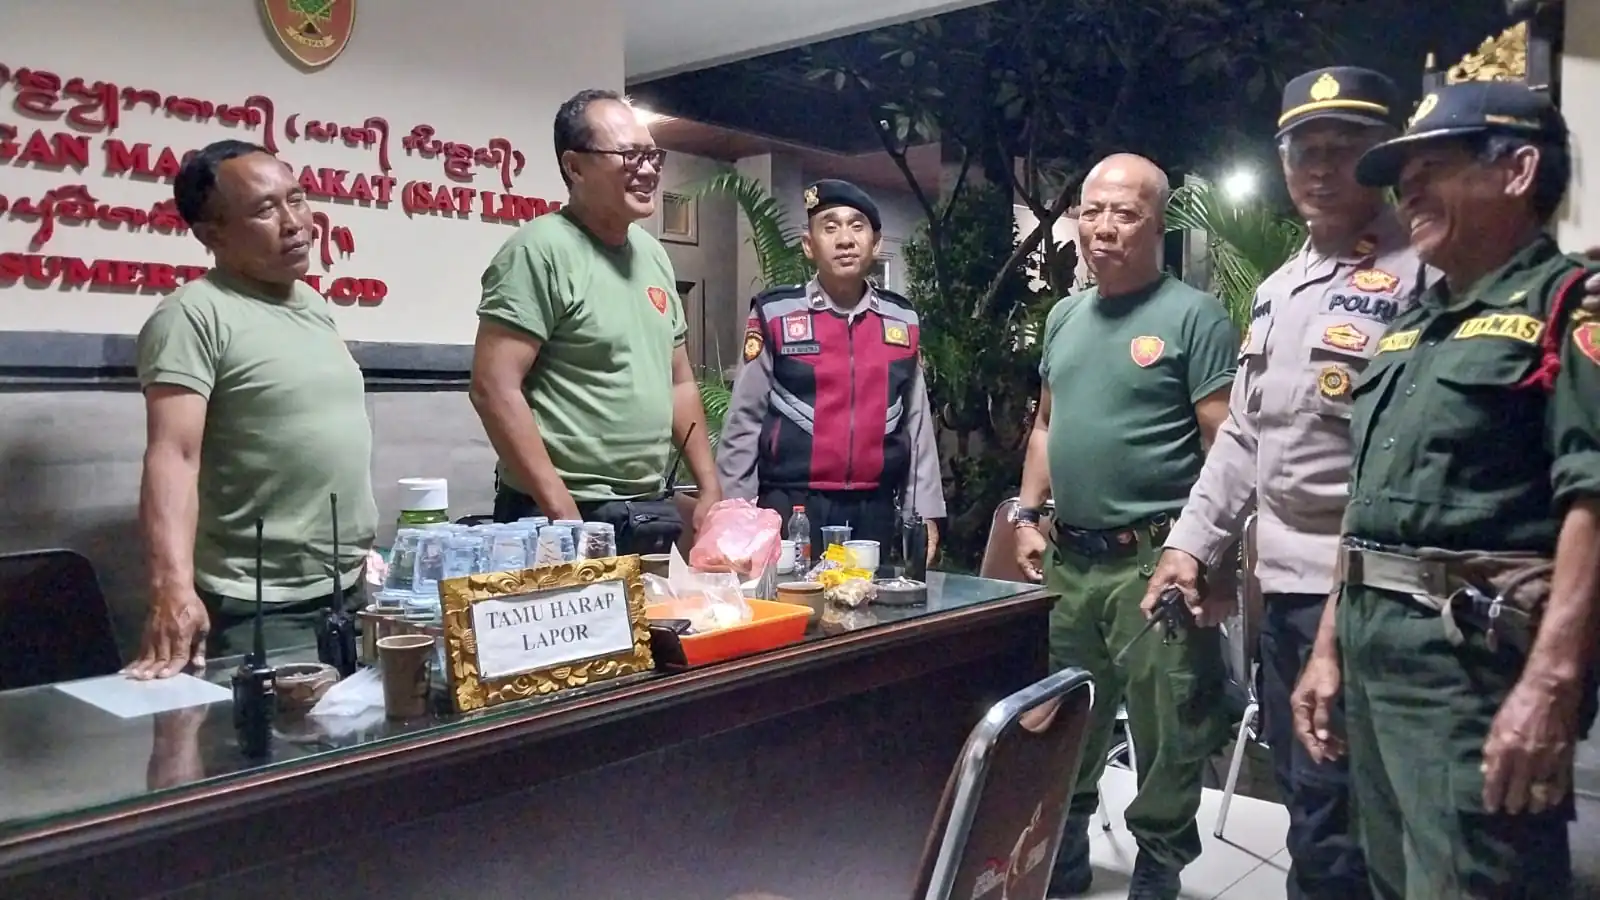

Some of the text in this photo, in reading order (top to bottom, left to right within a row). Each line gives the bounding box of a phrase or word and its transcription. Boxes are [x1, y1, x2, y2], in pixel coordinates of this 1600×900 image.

[402, 180, 476, 218] (SAT
[0, 252, 210, 291] SUMERT
[1328, 294, 1399, 322] POLRI
[486, 592, 615, 630] TAMU HARAP
[520, 624, 589, 651] LAPOR
